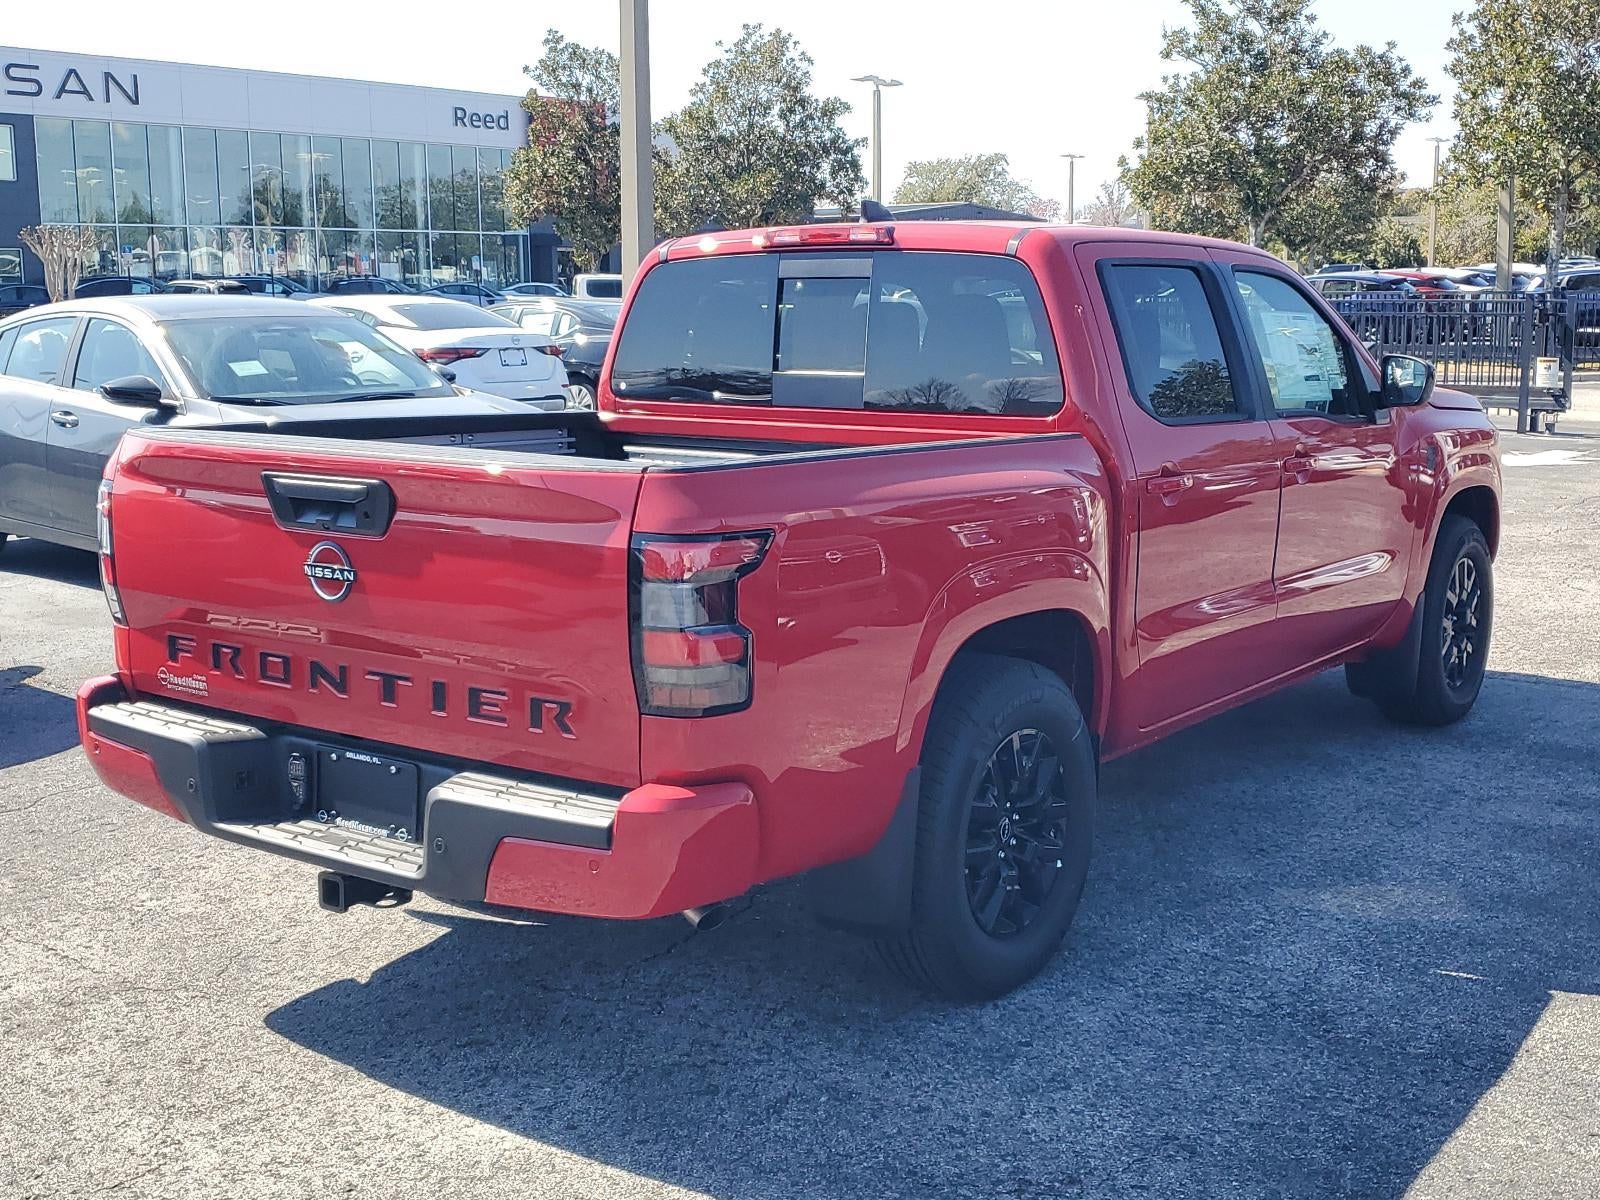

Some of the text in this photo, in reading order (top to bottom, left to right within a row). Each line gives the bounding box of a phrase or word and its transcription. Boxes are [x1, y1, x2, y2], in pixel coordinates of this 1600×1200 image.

[454, 106, 510, 131] Reed
[304, 564, 354, 581] NISSAN
[166, 633, 577, 739] FRONTIER
